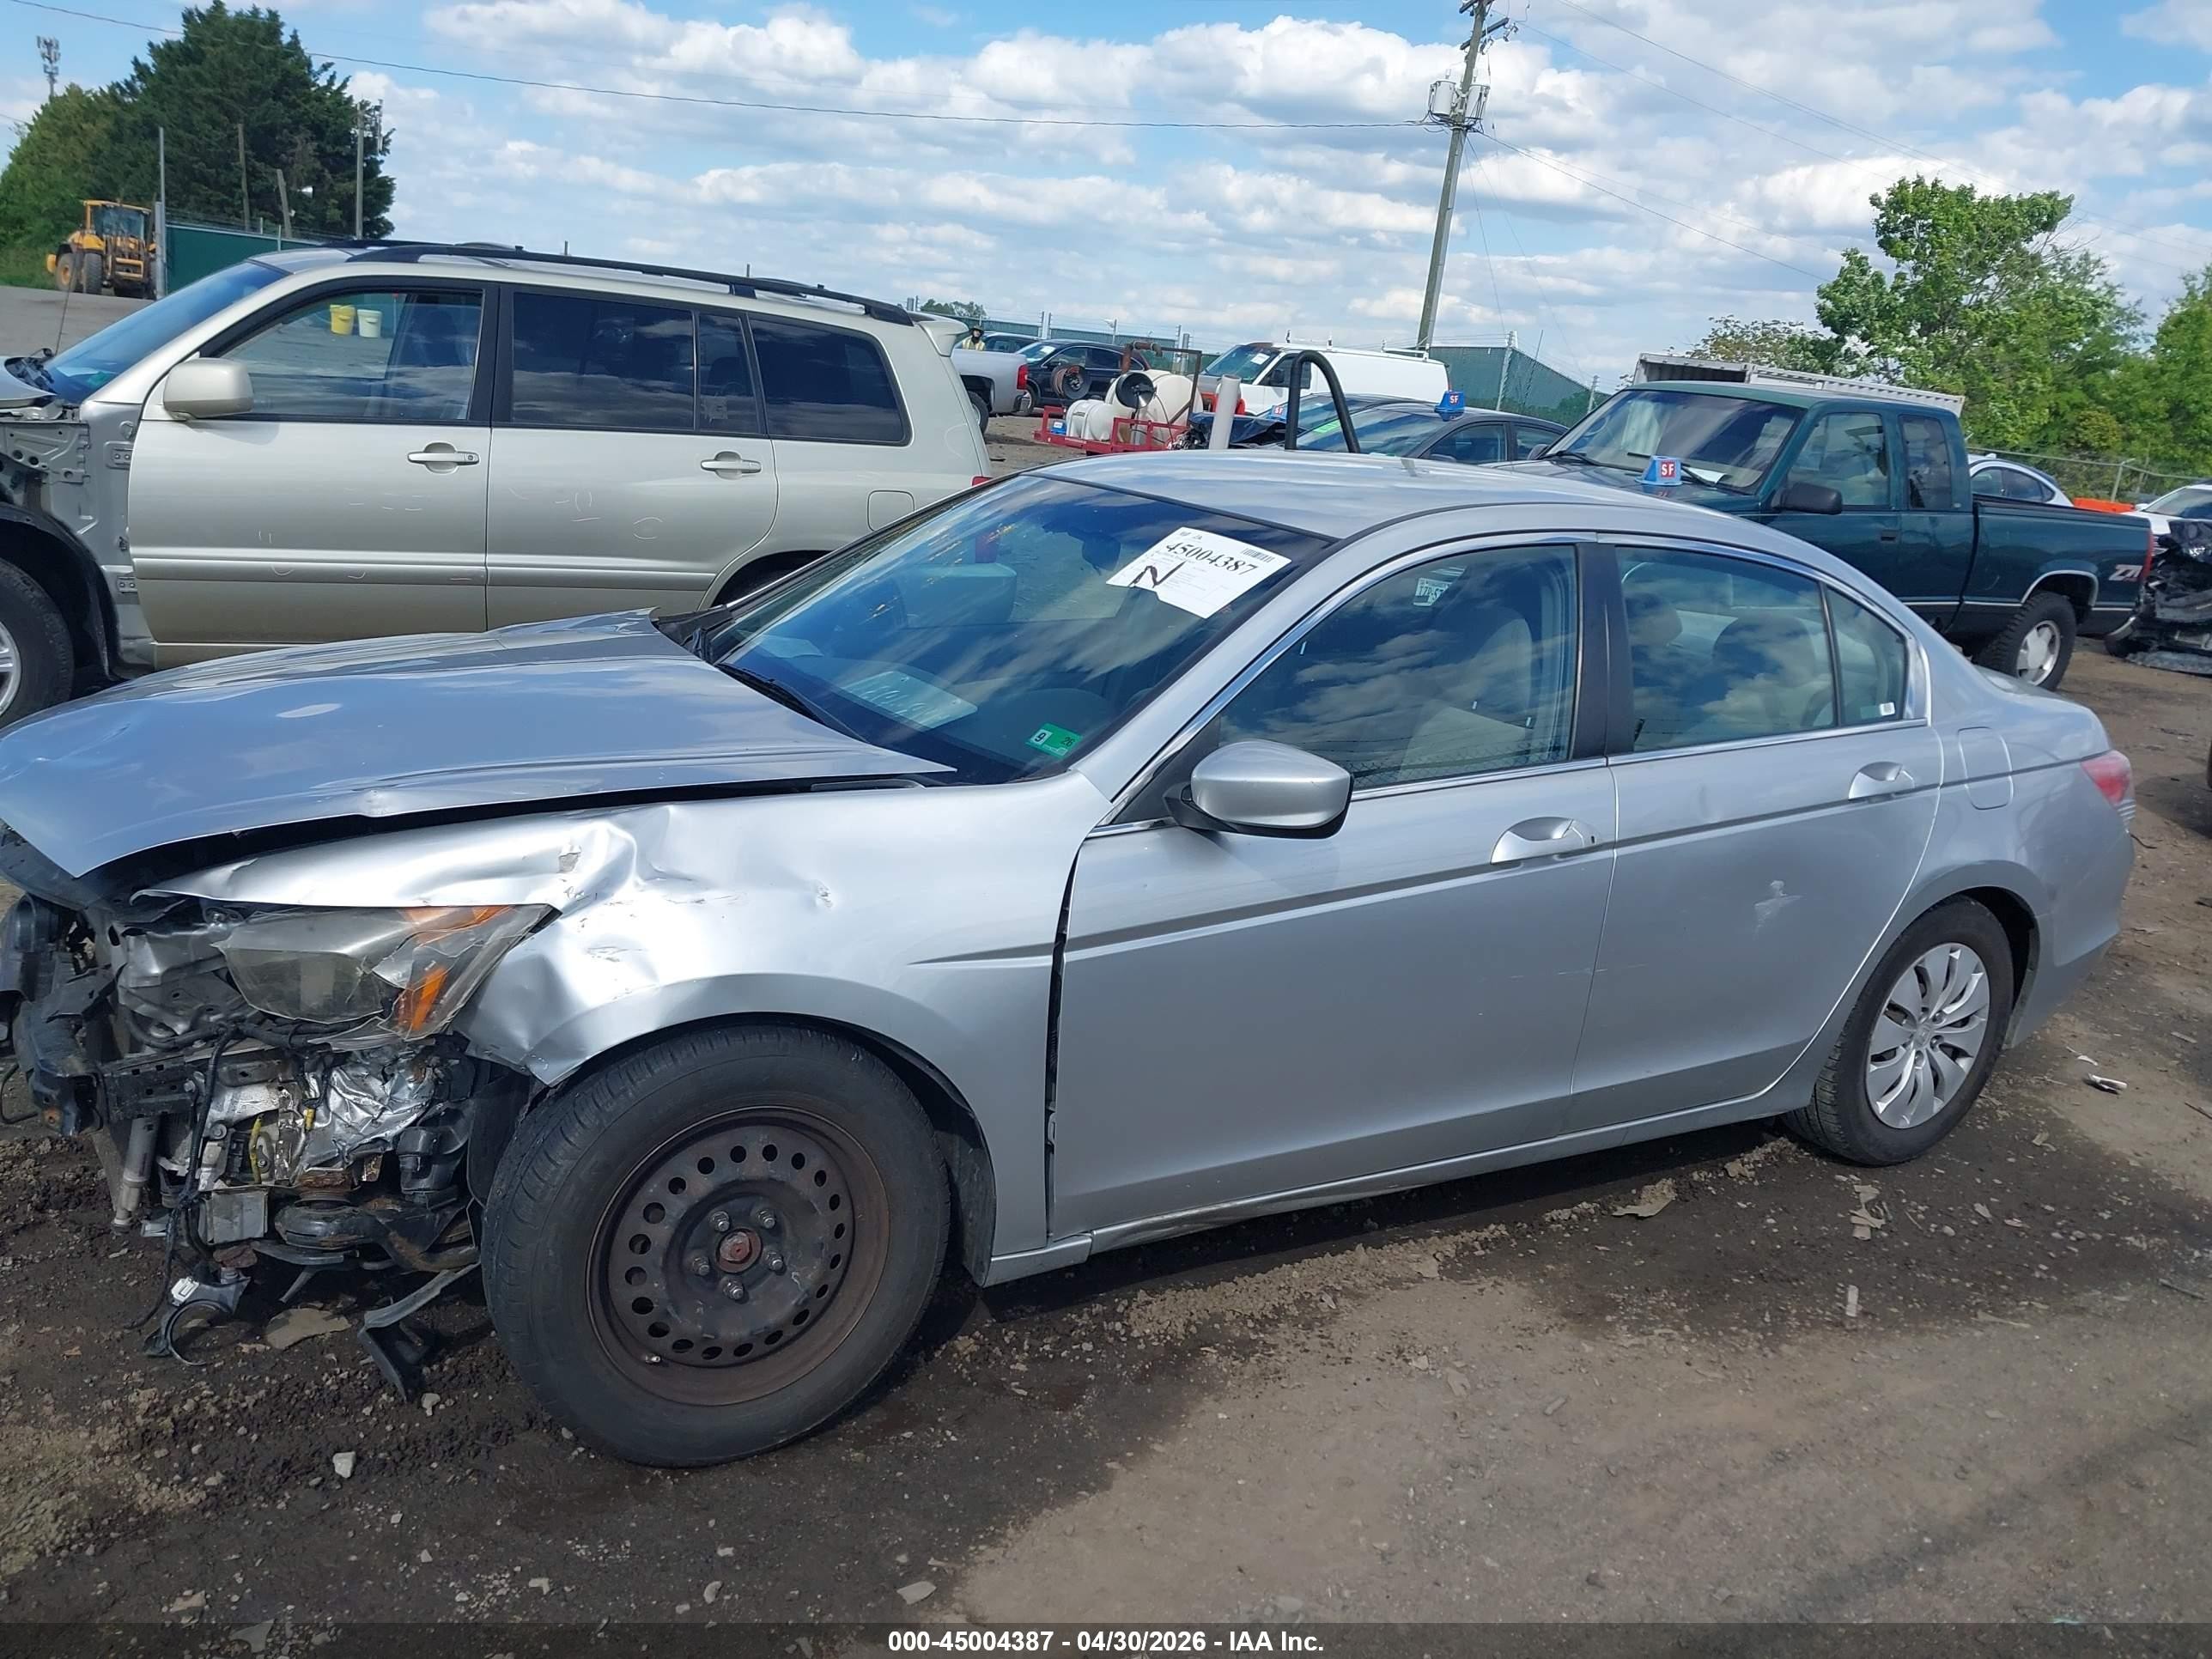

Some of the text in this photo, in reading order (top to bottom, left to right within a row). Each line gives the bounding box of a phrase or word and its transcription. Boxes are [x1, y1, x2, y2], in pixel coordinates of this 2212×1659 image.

[1661, 464, 1674, 476] SF
[1165, 542, 1259, 574] 45004387
[1035, 732, 1046, 742] 9
